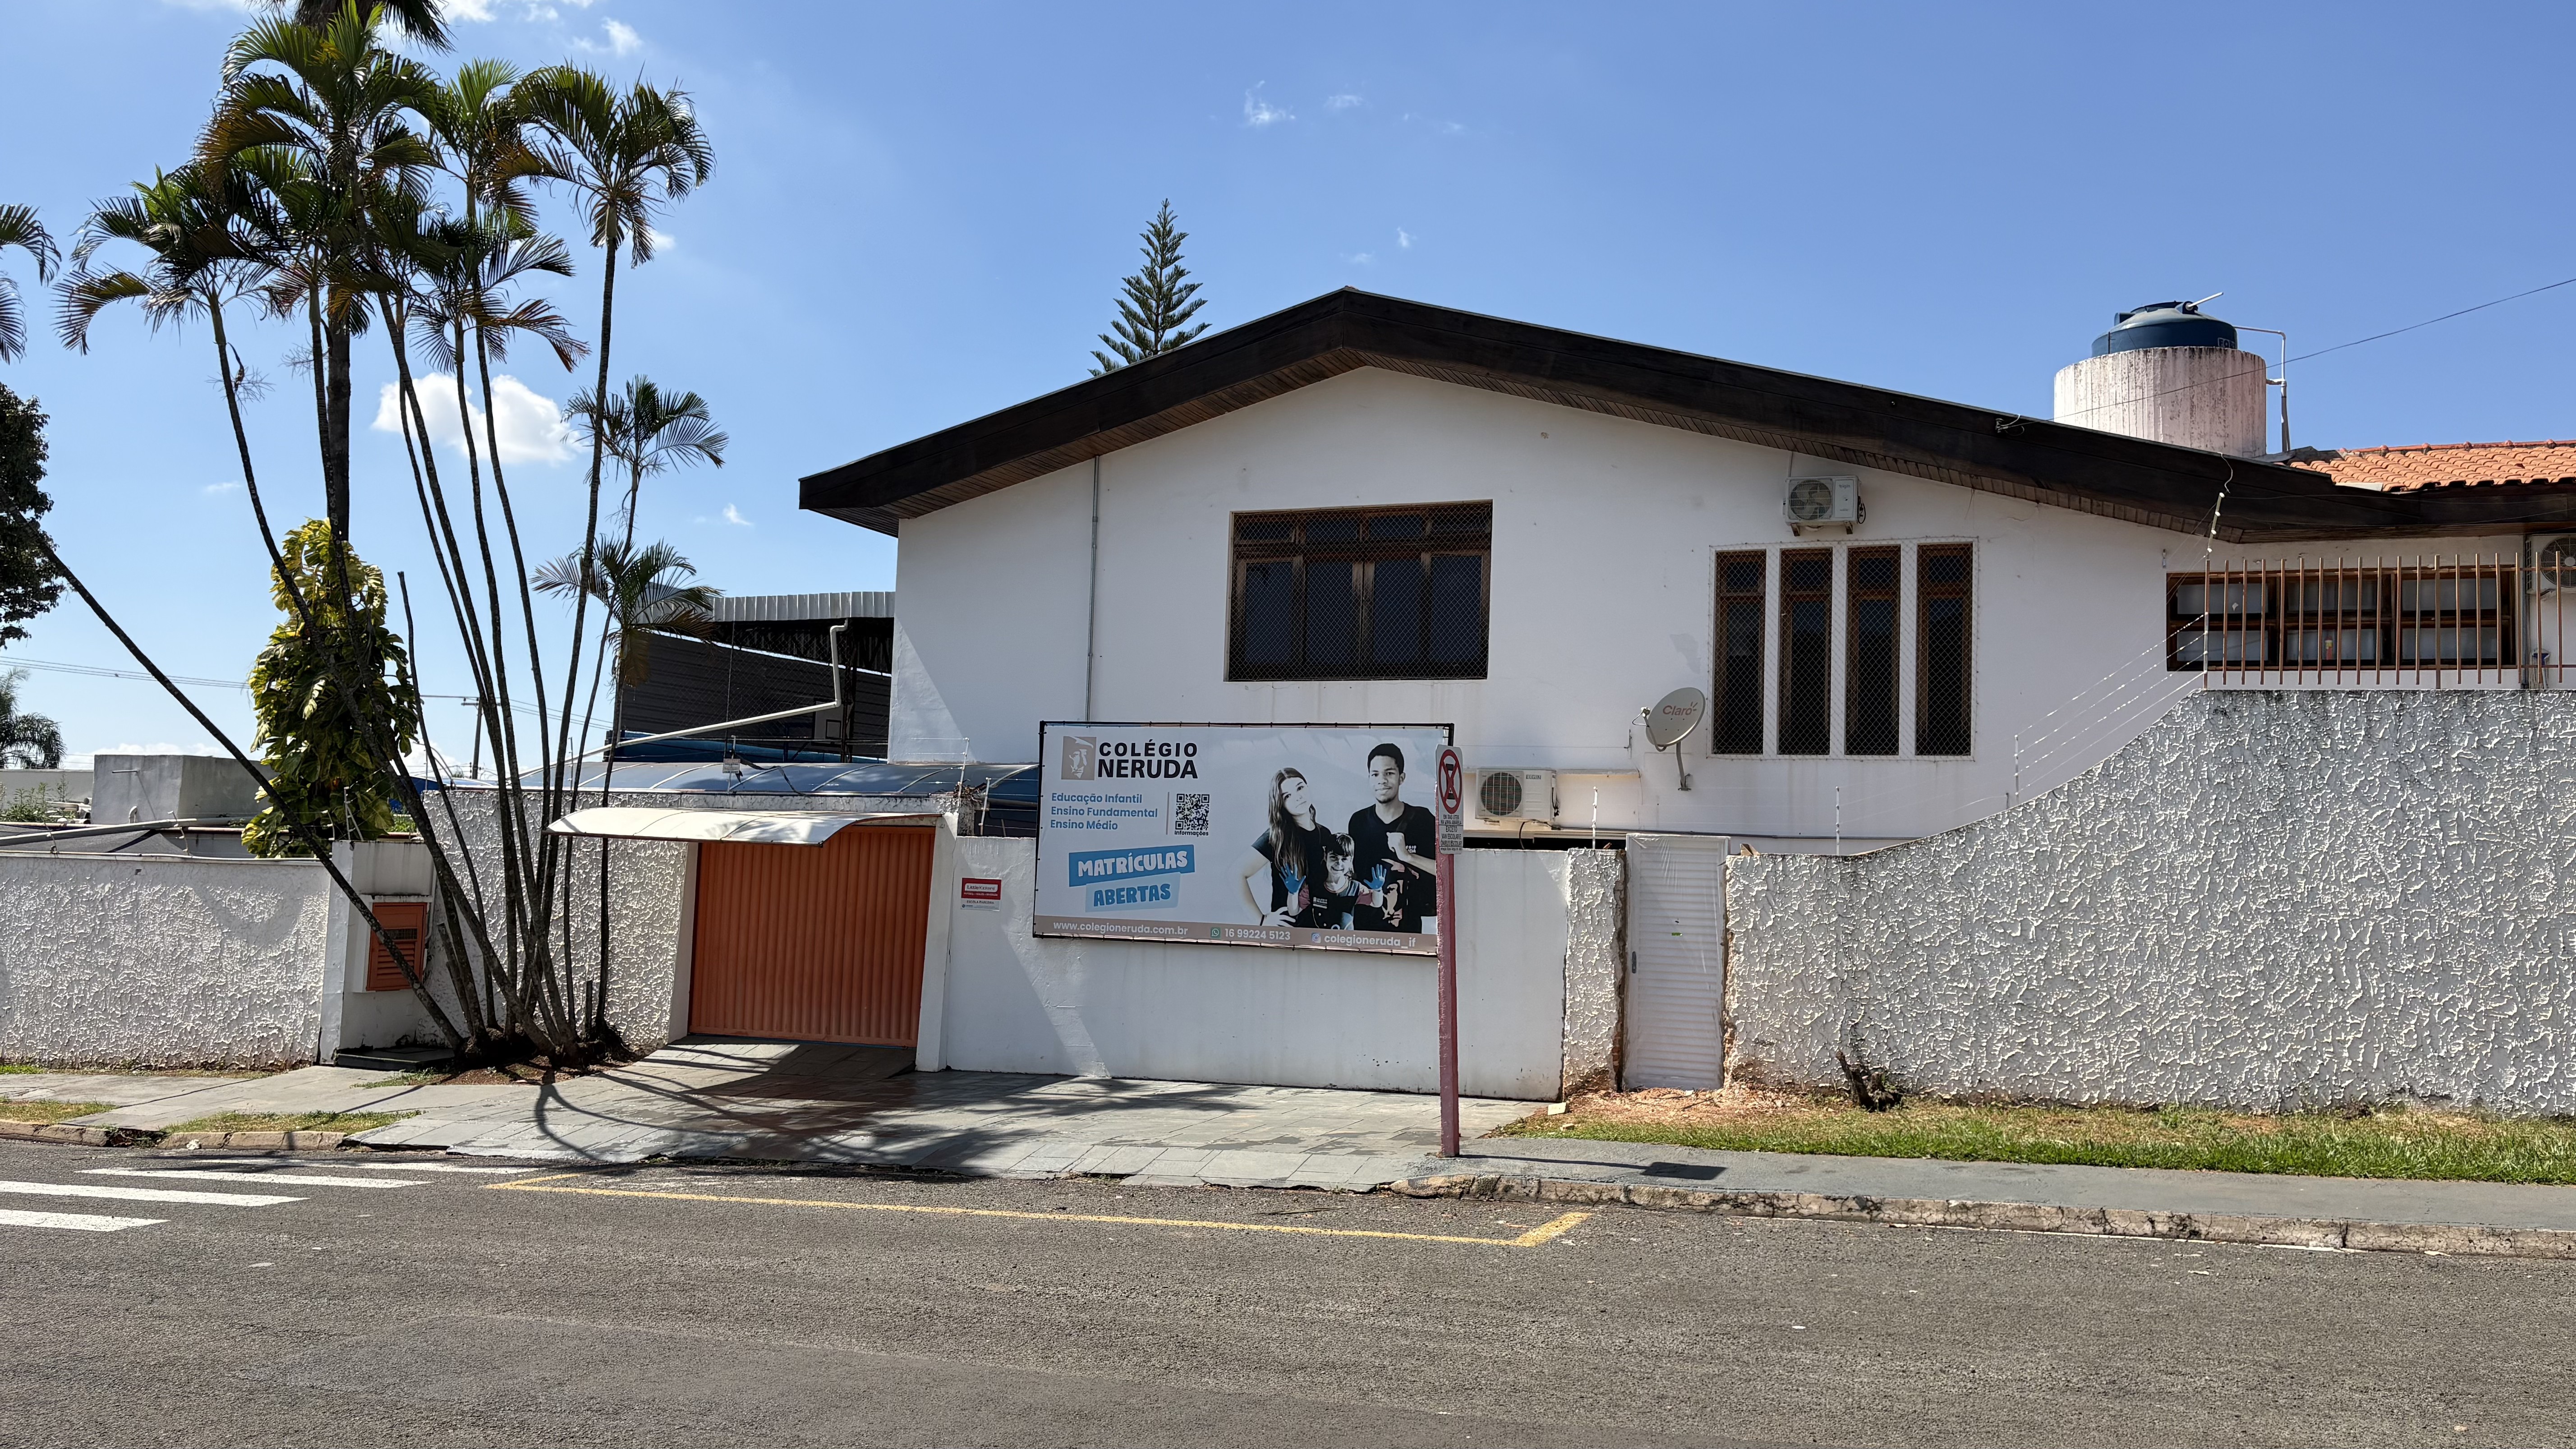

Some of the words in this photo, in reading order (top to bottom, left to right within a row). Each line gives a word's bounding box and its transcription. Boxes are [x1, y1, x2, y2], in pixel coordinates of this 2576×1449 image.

[1663, 705, 1692, 716] Claro
[1099, 739, 1197, 757] COLÉGIO
[1098, 759, 1198, 779] NERUDA
[1052, 793, 1103, 805] Educação
[1105, 793, 1142, 804] Infantil
[1051, 805, 1085, 816] Ensino
[1087, 807, 1158, 818] Fundamental
[1050, 819, 1084, 829] Ensino
[1086, 820, 1118, 830] Médio
[1078, 851, 1188, 877] MATRÍCULAS
[1094, 883, 1171, 906] ABERTAS
[1053, 922, 1188, 935] www.colegioneruda.com.br
[1225, 928, 1235, 937] 16
[1237, 929, 1267, 939] 99224
[1269, 931, 1291, 940] 5123
[1324, 934, 1416, 948] colegioneruda_if
